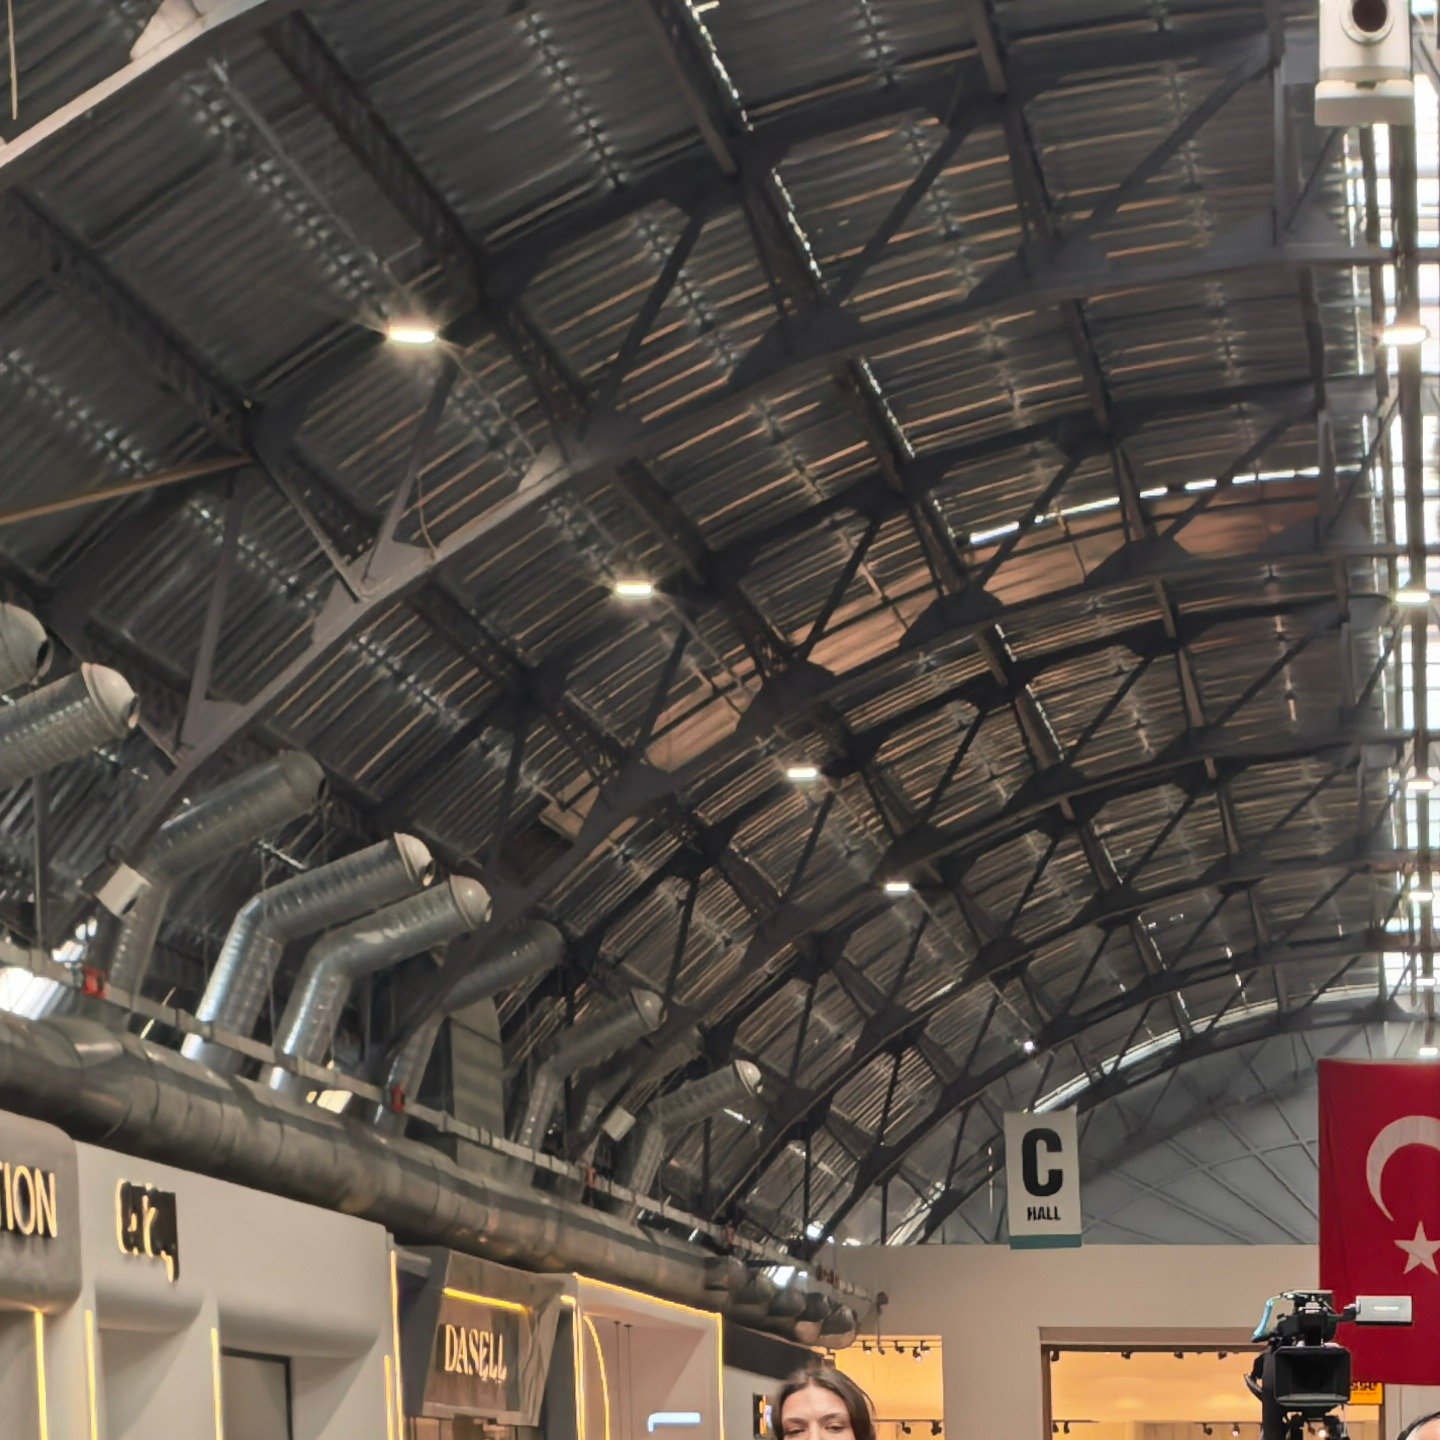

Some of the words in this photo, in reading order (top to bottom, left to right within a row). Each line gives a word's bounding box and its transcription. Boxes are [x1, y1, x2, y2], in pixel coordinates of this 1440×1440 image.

[1022, 1128, 1063, 1197] C
[1026, 1205, 1061, 1221] HALL
[444, 1323, 507, 1382] DASELL
